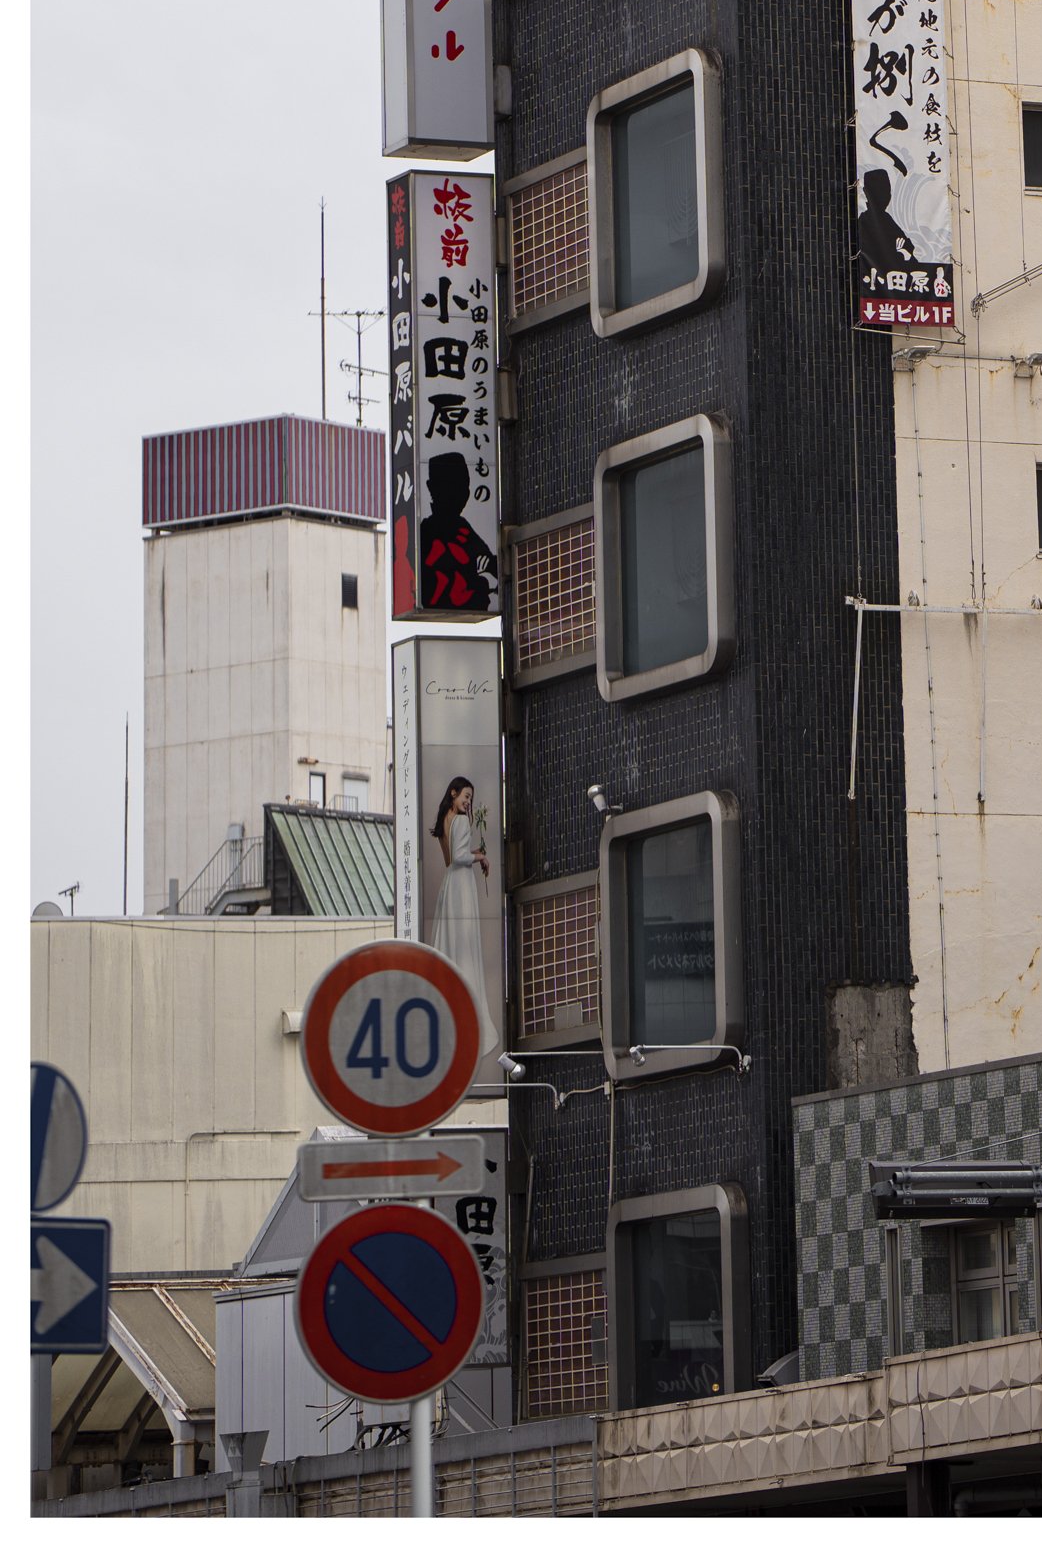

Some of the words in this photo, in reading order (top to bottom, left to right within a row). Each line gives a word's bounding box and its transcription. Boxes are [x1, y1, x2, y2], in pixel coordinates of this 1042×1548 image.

[433, 177, 475, 268] 板前
[862, 267, 930, 294] 小田原
[878, 303, 953, 325] 当ビル1F
[391, 257, 414, 507] 小田原バル
[421, 275, 471, 442] 小田原
[468, 277, 491, 504] 小田原のうまいもの
[425, 526, 476, 608] バル
[345, 996, 440, 1080] 40
